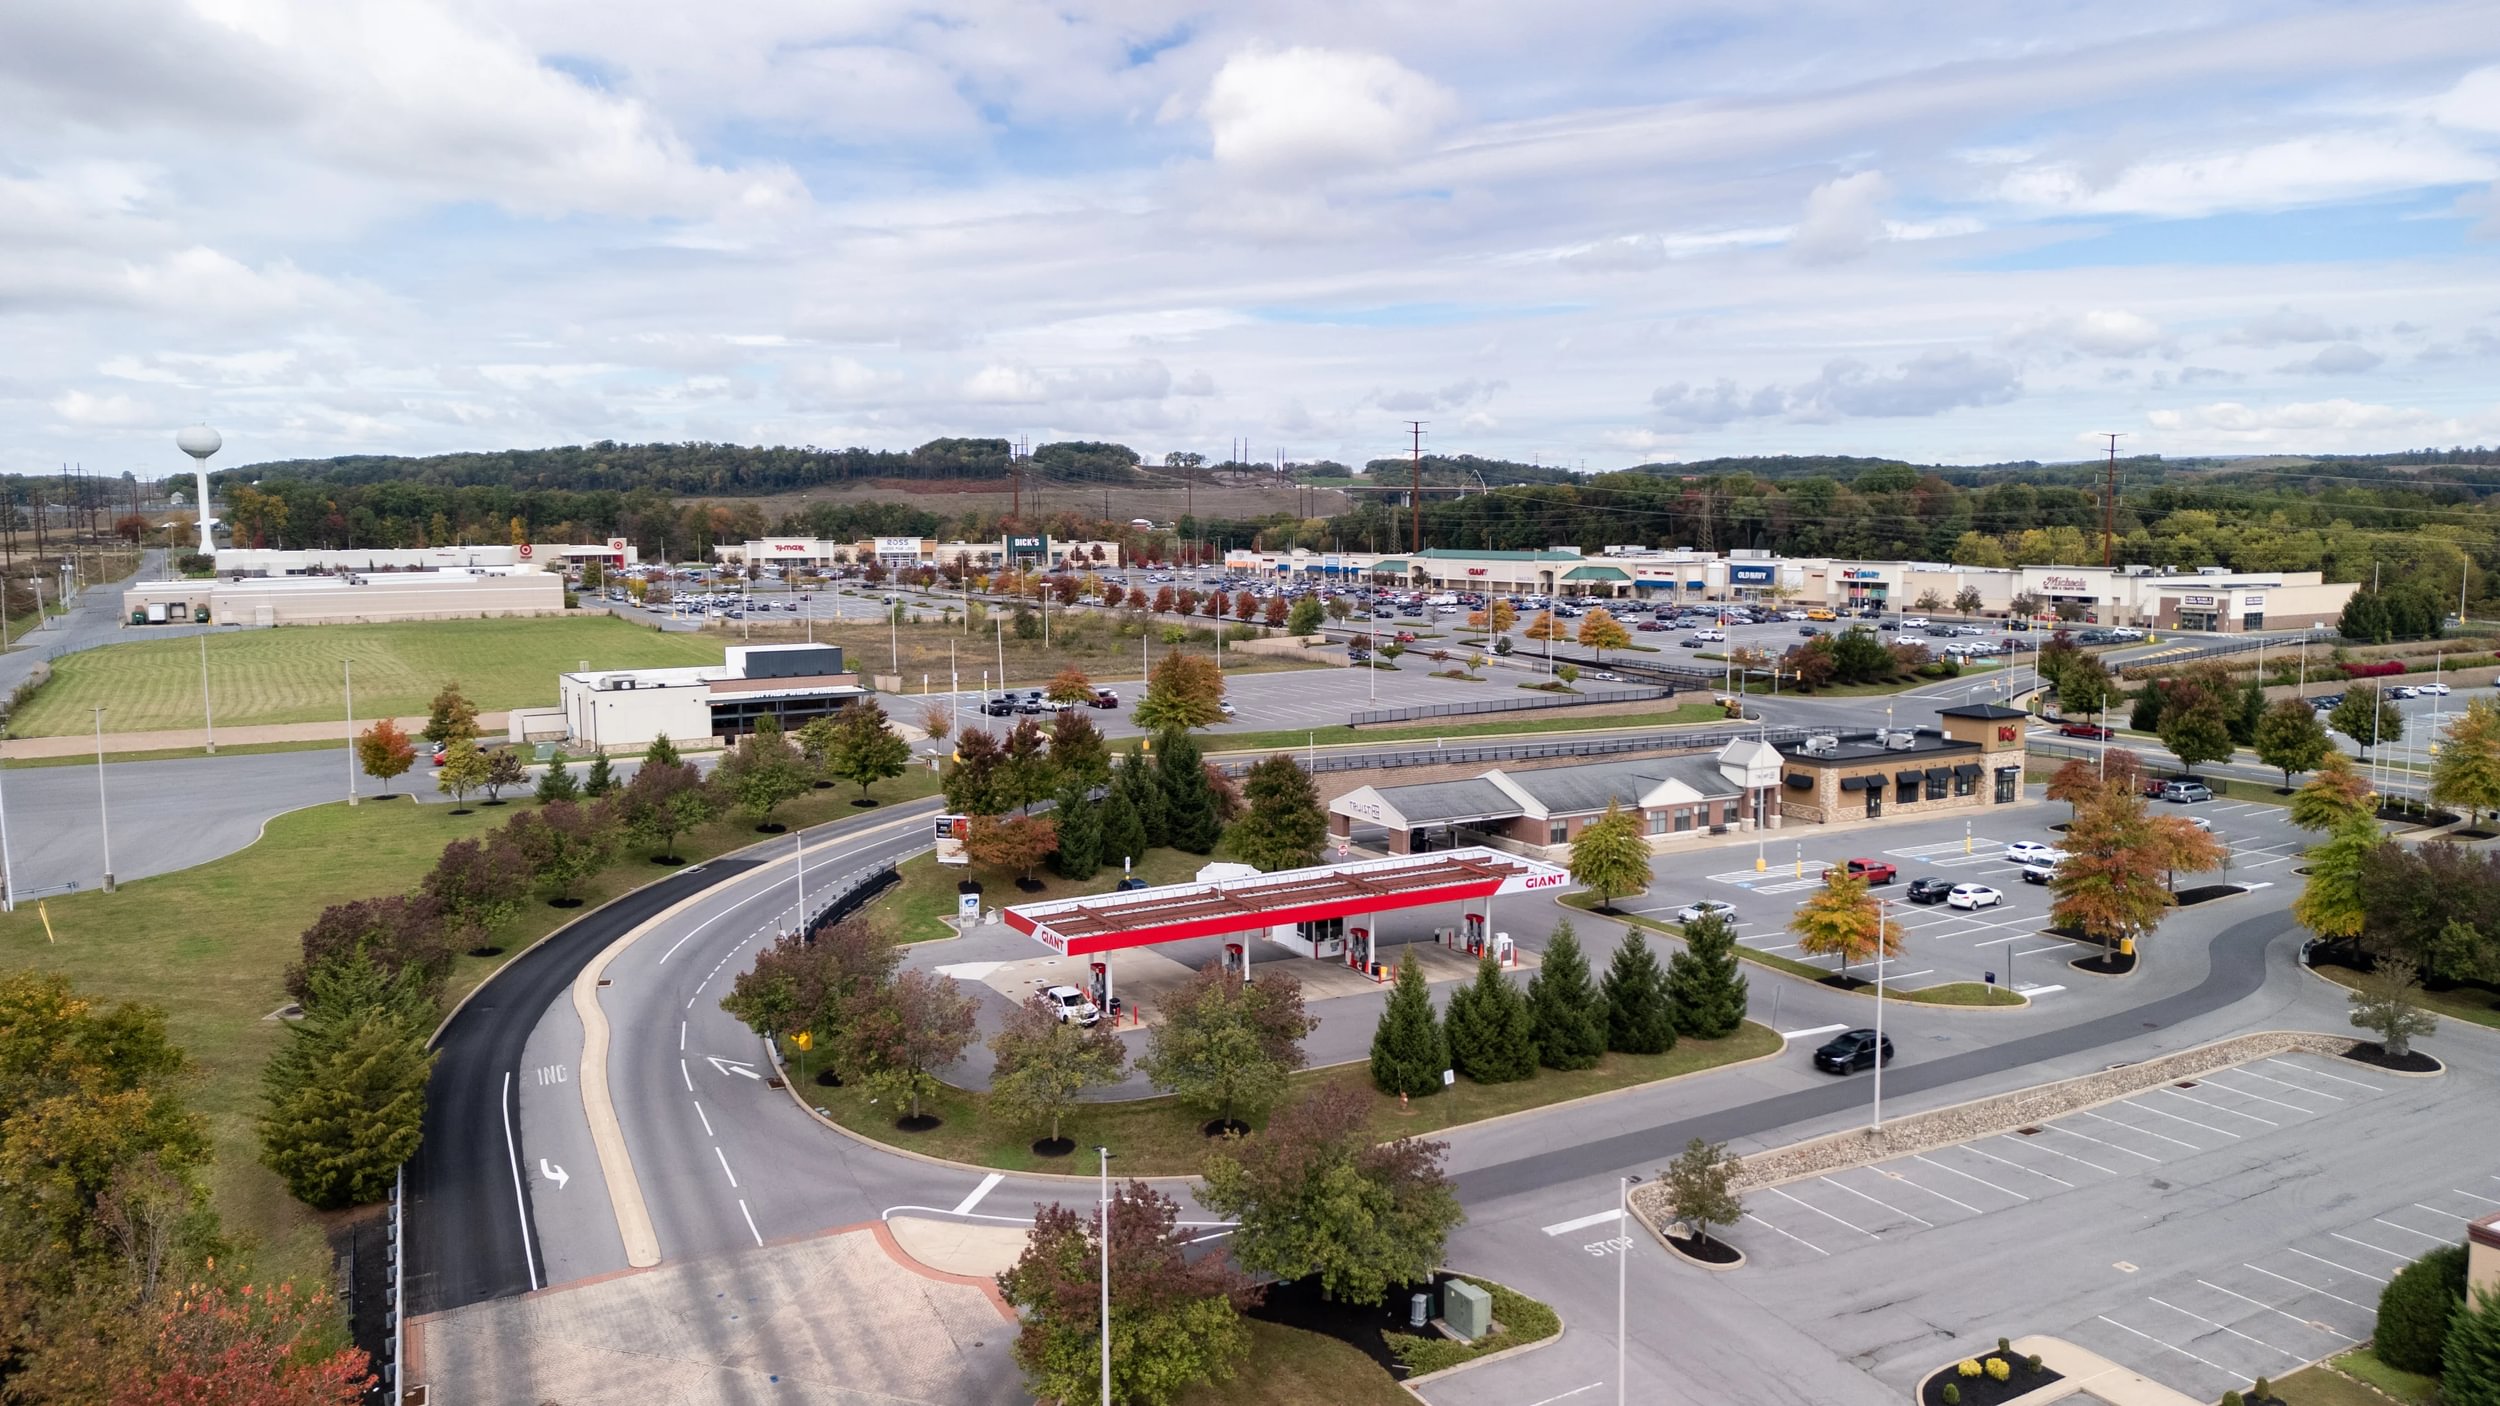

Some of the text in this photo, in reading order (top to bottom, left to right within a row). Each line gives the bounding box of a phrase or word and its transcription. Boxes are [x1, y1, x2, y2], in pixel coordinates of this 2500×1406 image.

[886, 538, 909, 546] ROSS
[1014, 537, 1040, 547] DICK'S
[2043, 576, 2087, 587] Michaels
[1525, 874, 1565, 889] GIANT
[1041, 930, 1064, 952] GIANT
[1584, 1235, 1635, 1257] STOP
